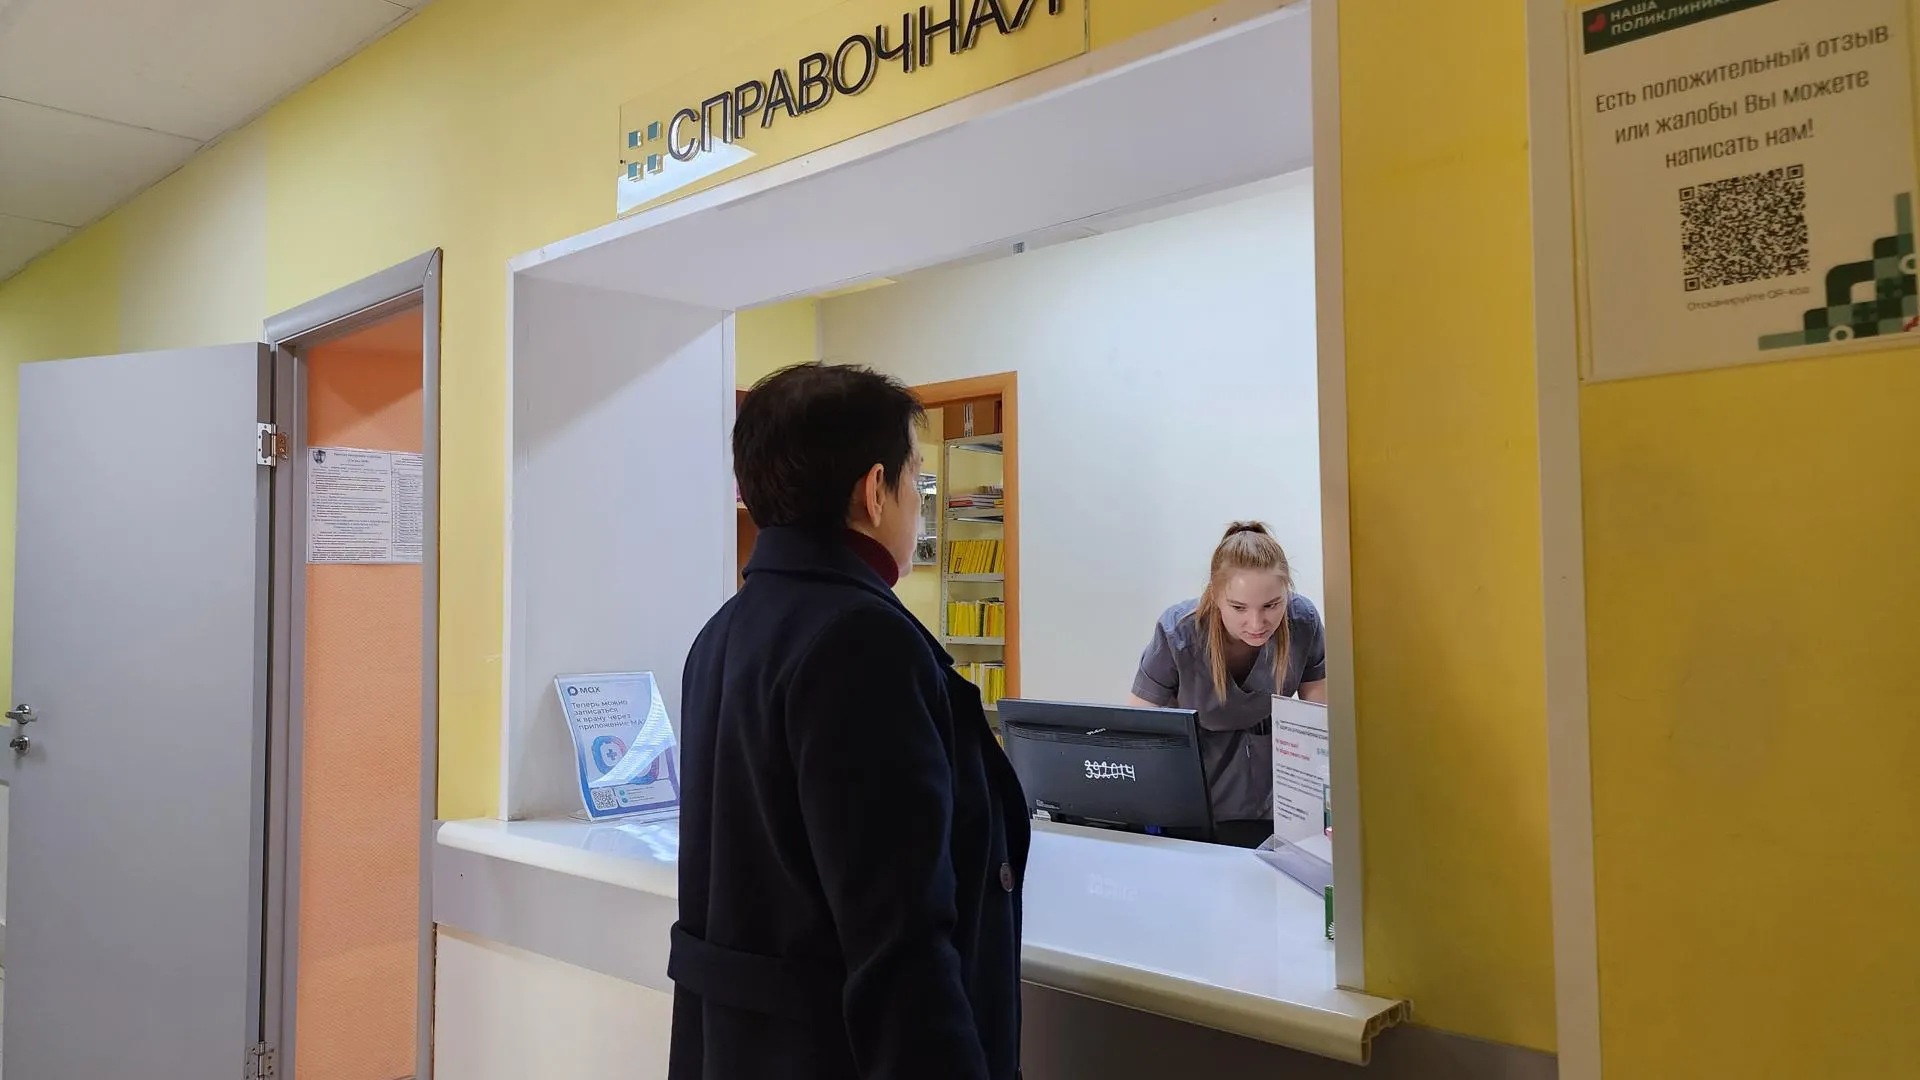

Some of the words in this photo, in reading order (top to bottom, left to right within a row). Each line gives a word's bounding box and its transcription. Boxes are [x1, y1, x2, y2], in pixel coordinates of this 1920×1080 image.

[1610, 0, 1658, 22] НАША
[668, 0, 1060, 162] СПРАВОЧНА
[1596, 89, 1636, 113] Есть
[1642, 42, 1810, 102] положительный
[1816, 25, 1889, 58] отзыв
[1615, 122, 1650, 144] или
[1656, 101, 1738, 134] жалобы
[1745, 92, 1776, 114] Вы
[1783, 70, 1869, 105] можете
[1665, 135, 1759, 168] написать
[1765, 118, 1815, 147] нам!
[574, 707, 619, 716] записаться
[601, 699, 628, 707] можно
